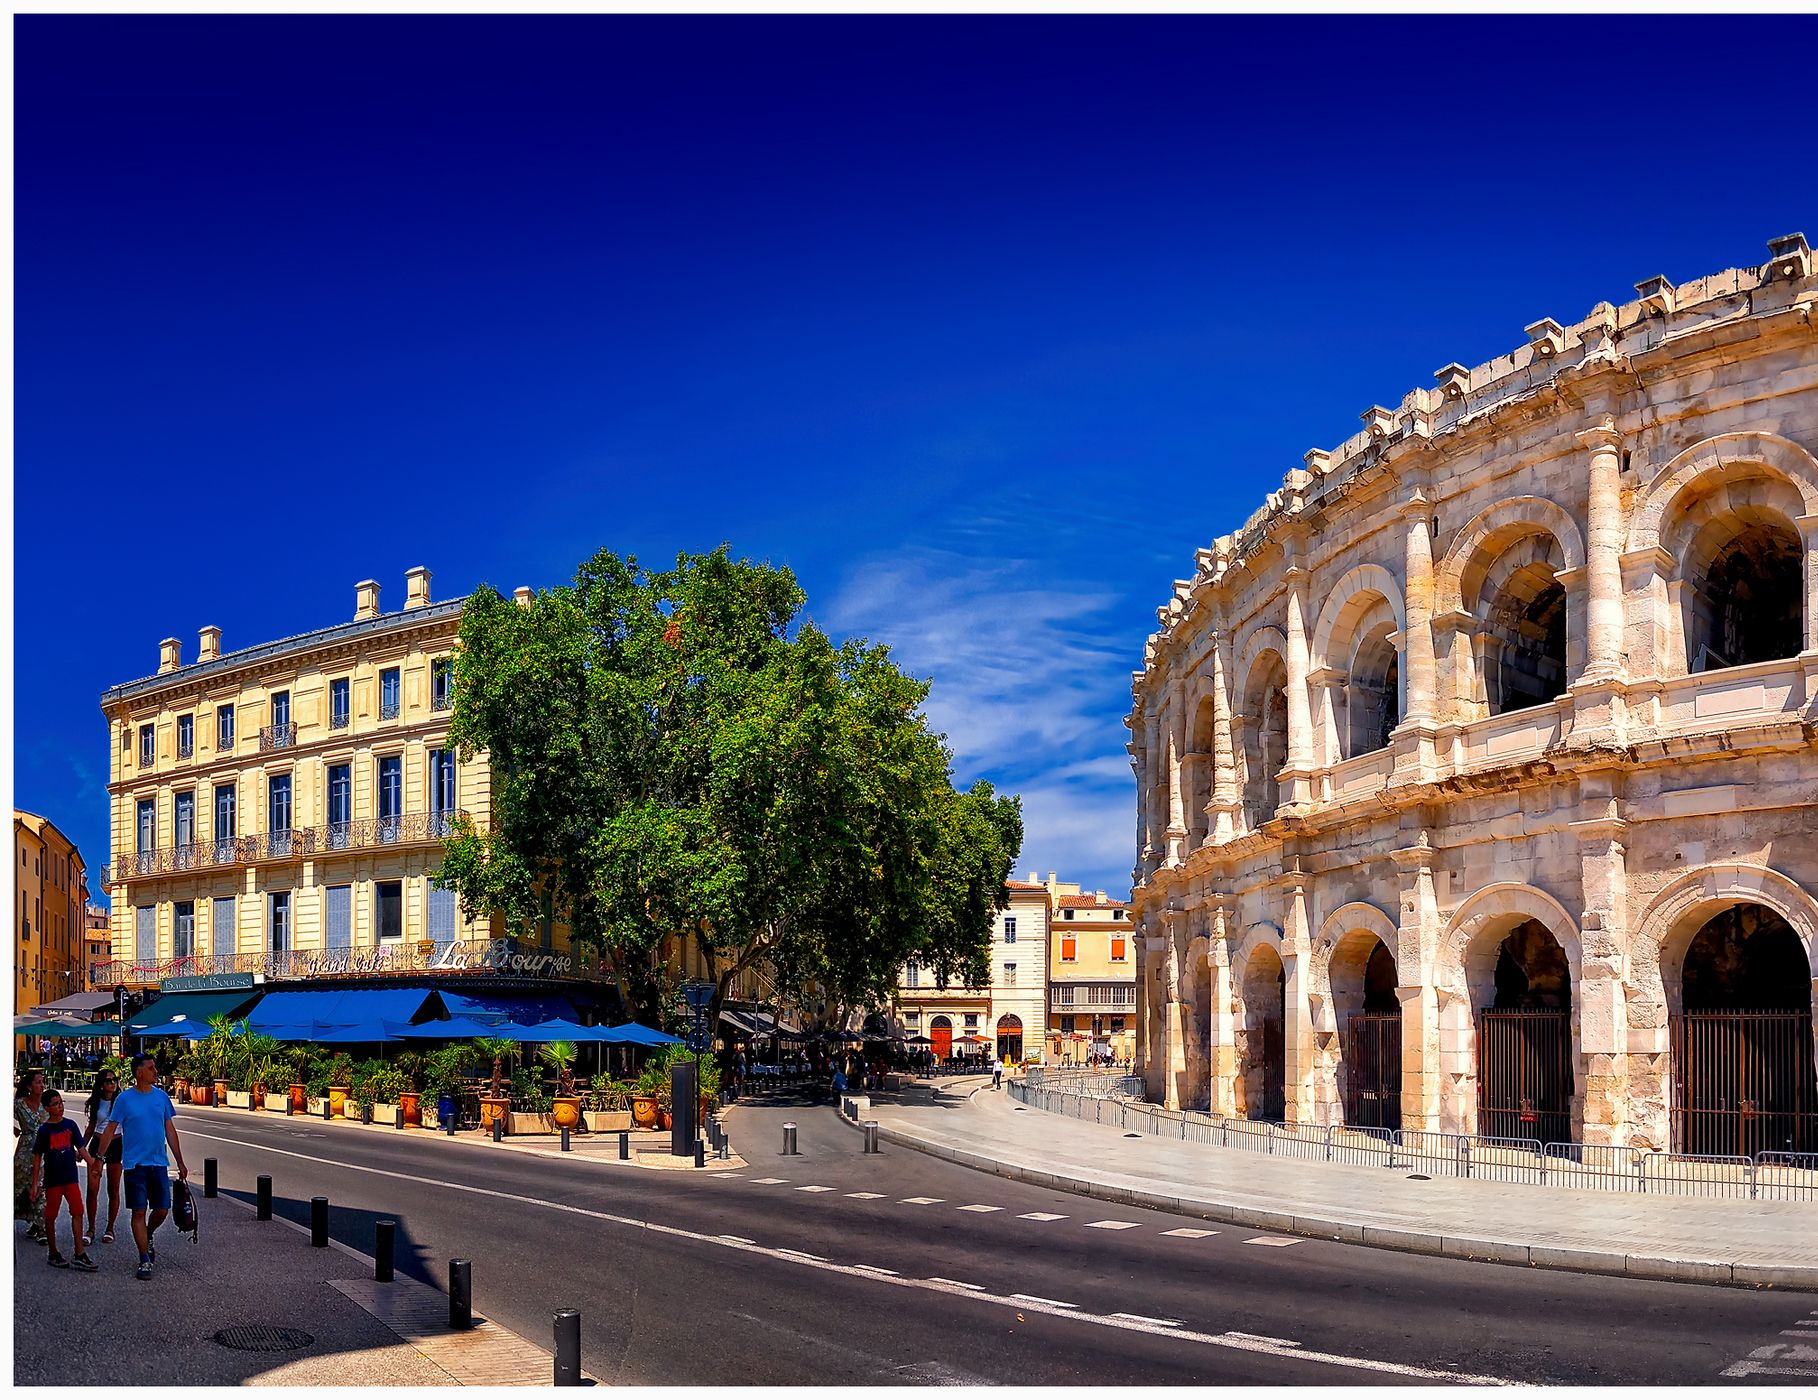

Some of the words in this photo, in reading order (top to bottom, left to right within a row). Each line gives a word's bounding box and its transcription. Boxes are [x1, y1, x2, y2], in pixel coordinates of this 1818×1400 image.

[308, 955, 349, 976] Grand
[432, 939, 470, 970] La
[482, 937, 572, 973] Bourse
[164, 980, 182, 990] Bar
[209, 976, 250, 987] Bourse
